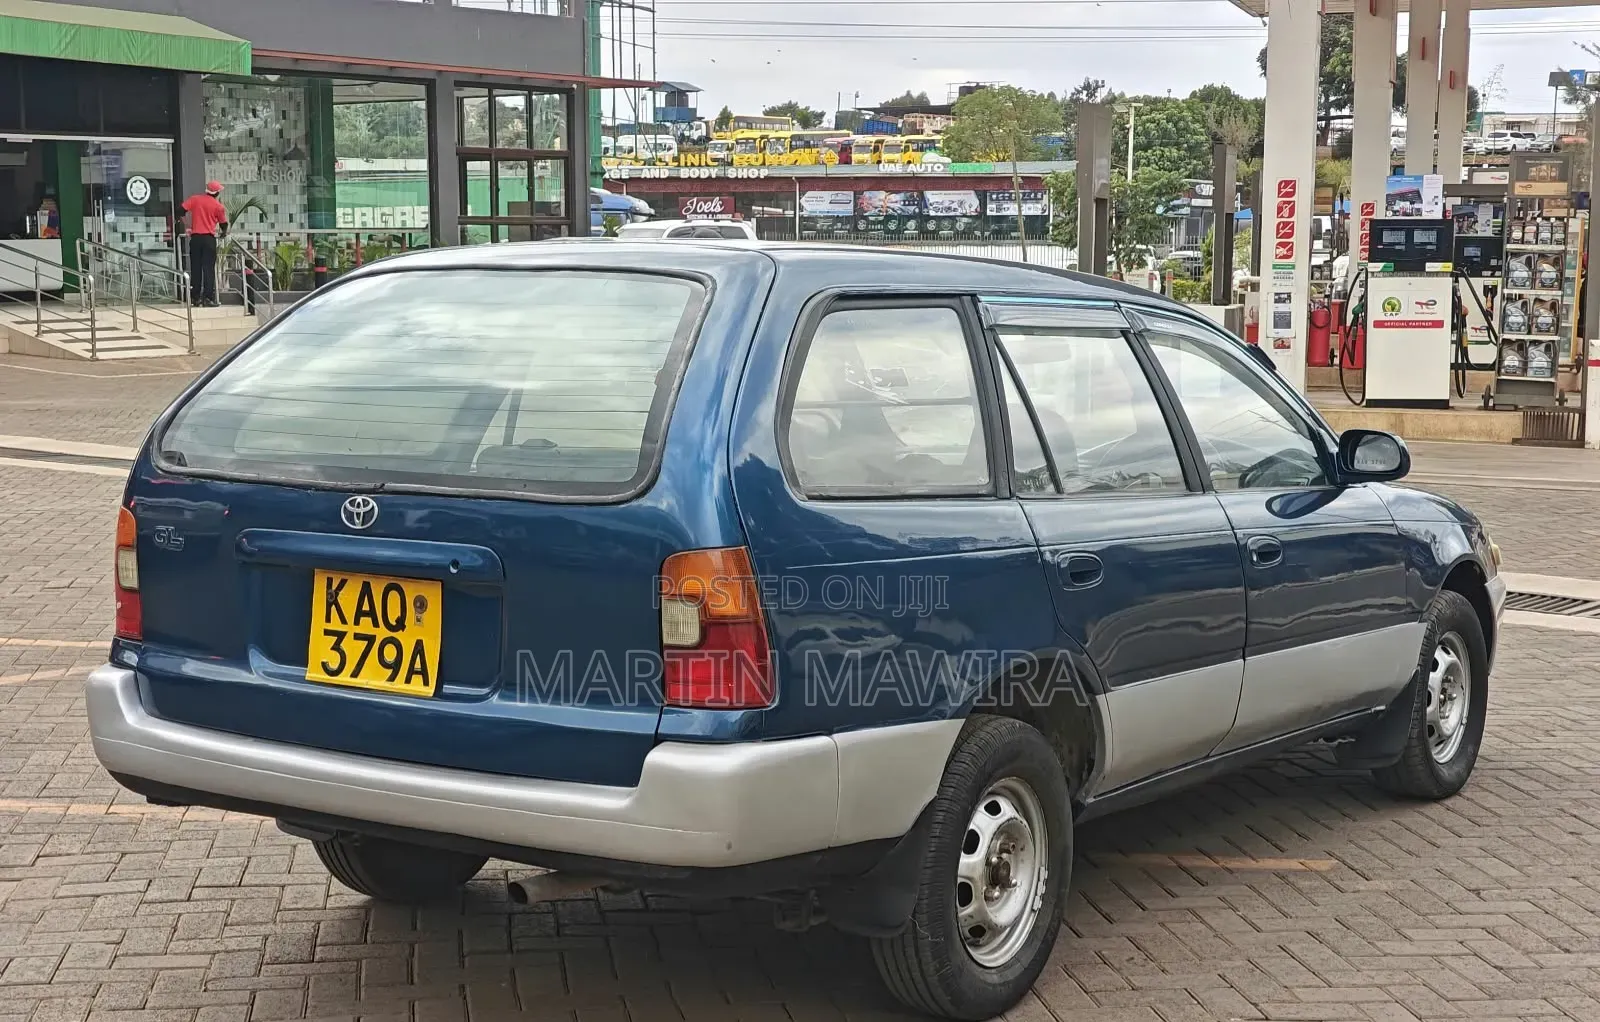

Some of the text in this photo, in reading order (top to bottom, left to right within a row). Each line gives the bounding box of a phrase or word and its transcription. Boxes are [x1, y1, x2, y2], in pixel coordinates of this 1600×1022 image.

[641, 168, 669, 179] AND
[680, 168, 718, 179] BODY
[727, 168, 769, 179] SHOP
[879, 163, 903, 172] UAE
[906, 163, 944, 172] AUTO
[325, 576, 408, 633] KAQ
[321, 628, 430, 687] 379A
